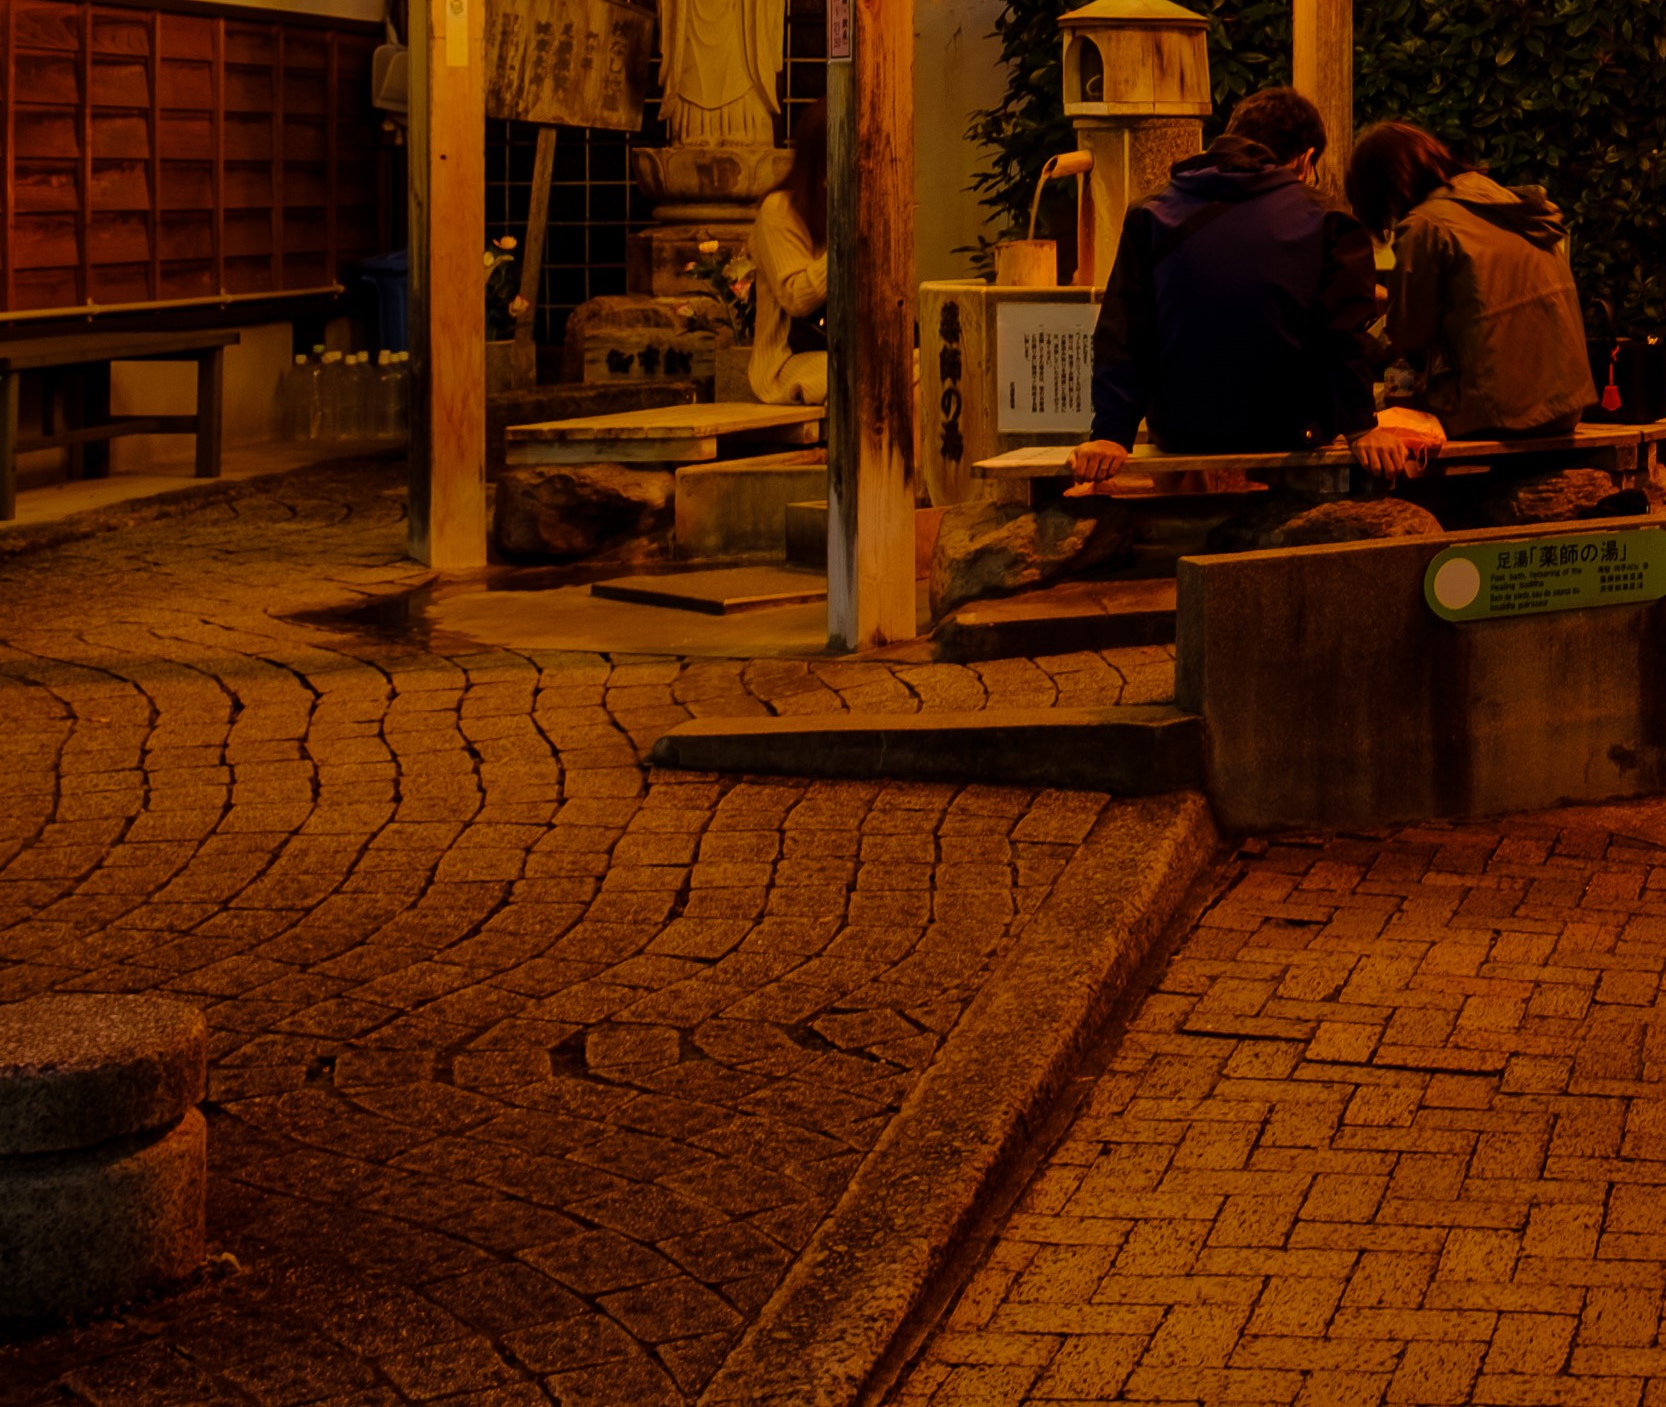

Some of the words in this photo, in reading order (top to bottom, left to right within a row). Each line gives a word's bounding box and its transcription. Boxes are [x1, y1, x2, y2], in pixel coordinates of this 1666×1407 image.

[1497, 540, 1627, 571] 足湯「薬師の湯」
